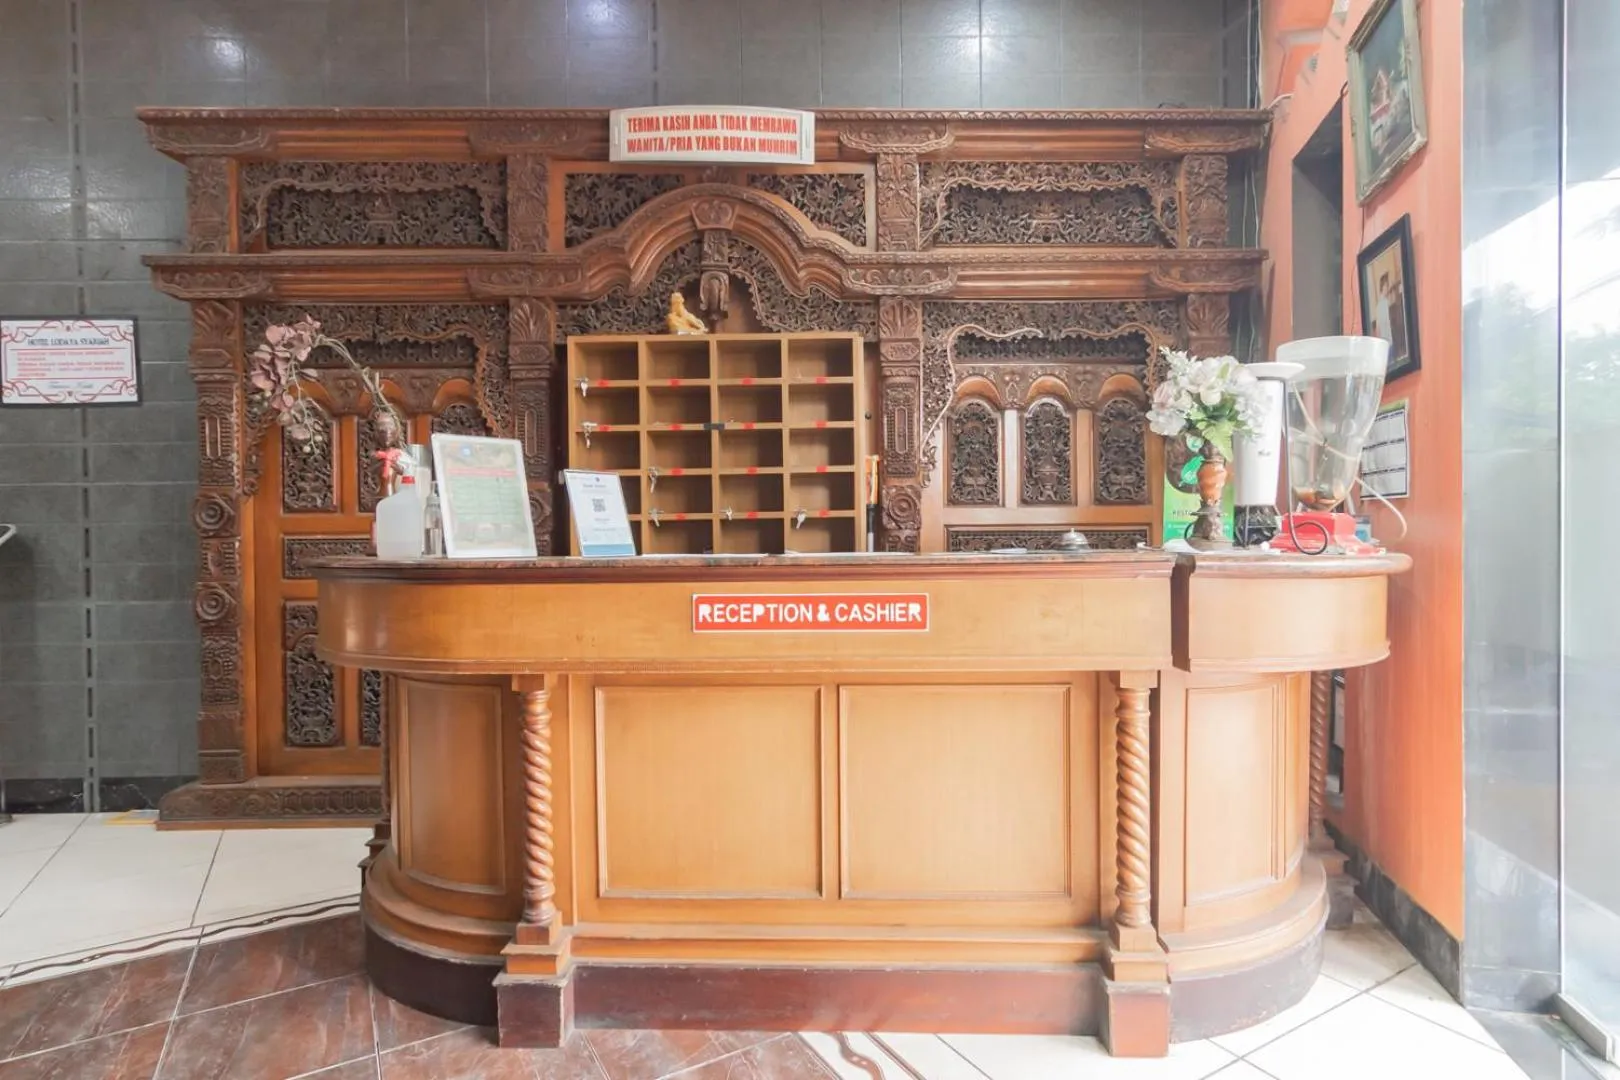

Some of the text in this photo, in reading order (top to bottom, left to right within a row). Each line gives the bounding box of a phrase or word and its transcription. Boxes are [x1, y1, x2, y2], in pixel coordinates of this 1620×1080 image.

[720, 114, 748, 130] TIDAK
[695, 135, 721, 151] YANG
[697, 603, 922, 623] RECEPTION & CASHIER
